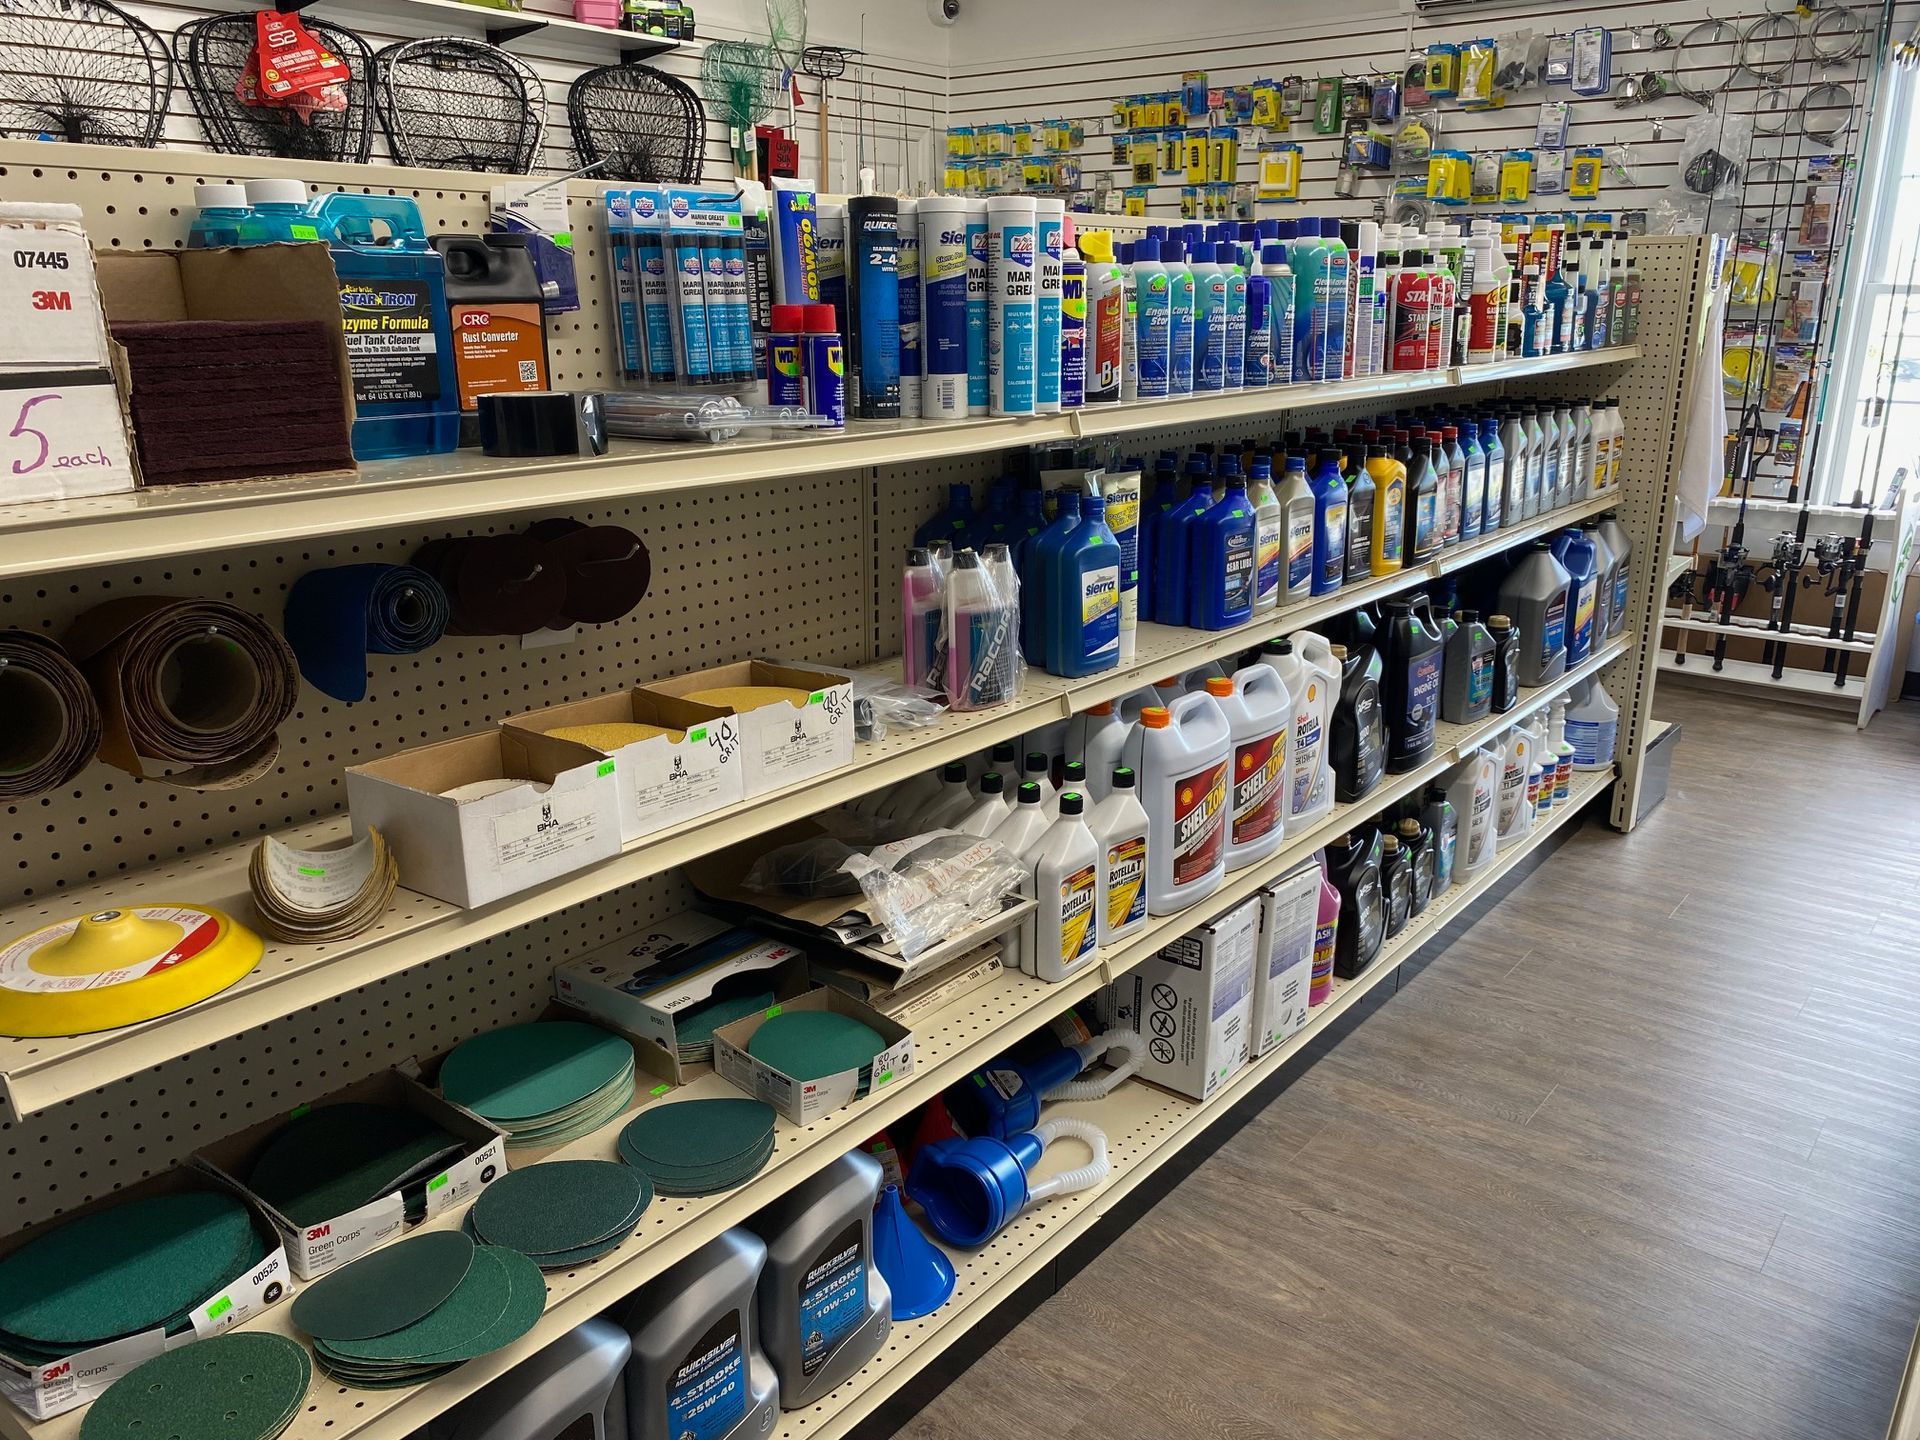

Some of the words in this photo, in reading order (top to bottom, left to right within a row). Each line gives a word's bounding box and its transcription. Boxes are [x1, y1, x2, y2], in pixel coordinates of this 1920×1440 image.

[268, 29, 297, 48] S2
[776, 141, 792, 153] Ugly
[863, 220, 897, 231] QUICKS
[1014, 242, 1033, 252] LUC
[13, 250, 69, 269] 07445
[747, 261, 757, 294] VISCOSITY
[757, 254, 769, 288] LUBE
[1007, 271, 1032, 282] MAR
[1062, 279, 1084, 300] WD-
[1405, 291, 1426, 302] STA
[32, 291, 72, 310] 3M
[341, 292, 376, 306] STAR
[380, 291, 416, 306] TRON
[750, 297, 758, 321] HIGH
[759, 291, 771, 327] GEAR
[1145, 307, 1169, 317] Engin
[1172, 306, 1189, 315] Carb
[342, 317, 378, 332] nzyme
[381, 315, 429, 330] Formula
[462, 313, 490, 325] CRC
[1150, 317, 1168, 326] Stor
[365, 335, 386, 346] Tank
[388, 335, 422, 346] Cleaner
[462, 332, 480, 343] Rust
[481, 331, 519, 342] Converter
[1078, 329, 1084, 338] 2
[368, 392, 376, 400] 64
[9, 394, 62, 474] 5
[52, 446, 112, 468] each
[1106, 491, 1138, 504] Sierra
[1260, 533, 1279, 545] Sierra
[1290, 524, 1311, 538] Sierra
[1226, 561, 1240, 573] GEAR
[1240, 557, 1252, 569] LUBE
[1085, 579, 1115, 597] Sierra
[1413, 682, 1432, 697] ENGINE
[829, 689, 852, 725] GRIT
[1297, 712, 1309, 724] Shell
[1297, 716, 1319, 737] ROTELLA
[709, 720, 732, 752] 40
[790, 732, 807, 743] BHA
[1296, 739, 1305, 748] T4
[720, 733, 739, 764] GRIT
[669, 769, 688, 781] BHA
[1240, 746, 1286, 804] SHELLZON
[1181, 777, 1226, 843] SHELLZON
[537, 819, 559, 832] BHA
[1109, 863, 1136, 883] ROTELLA
[1135, 860, 1142, 871] T
[1108, 879, 1124, 890] TRIPLE
[1062, 893, 1086, 917] ROTELLA
[1086, 888, 1092, 900] T
[1316, 928, 1331, 940] ASH
[162, 952, 184, 965] 3M
[767, 947, 792, 961] 3M
[987, 958, 1000, 972] 3M
[663, 995, 691, 1010] 01551
[873, 1055, 899, 1078] GRIT
[878, 1052, 889, 1066] 80
[803, 1084, 817, 1094] 3M
[474, 1145, 497, 1166] 00521
[306, 1224, 331, 1241] 3M
[308, 1240, 335, 1256] Green
[807, 1243, 859, 1281] QUICKSILVER
[252, 1258, 279, 1286] 00525
[805, 1276, 826, 1290] Marine
[825, 1254, 856, 1277] Lubricants
[801, 1264, 862, 1308] 4-STROKE
[815, 1287, 857, 1319] 10W-30
[677, 1332, 738, 1378] QUICKSILVER
[42, 1361, 71, 1382] 3M
[675, 1370, 700, 1388] Marine
[700, 1346, 734, 1373] Lubricants
[670, 1356, 741, 1407] 4-STROKE
[687, 1381, 736, 1419] 25W-40
